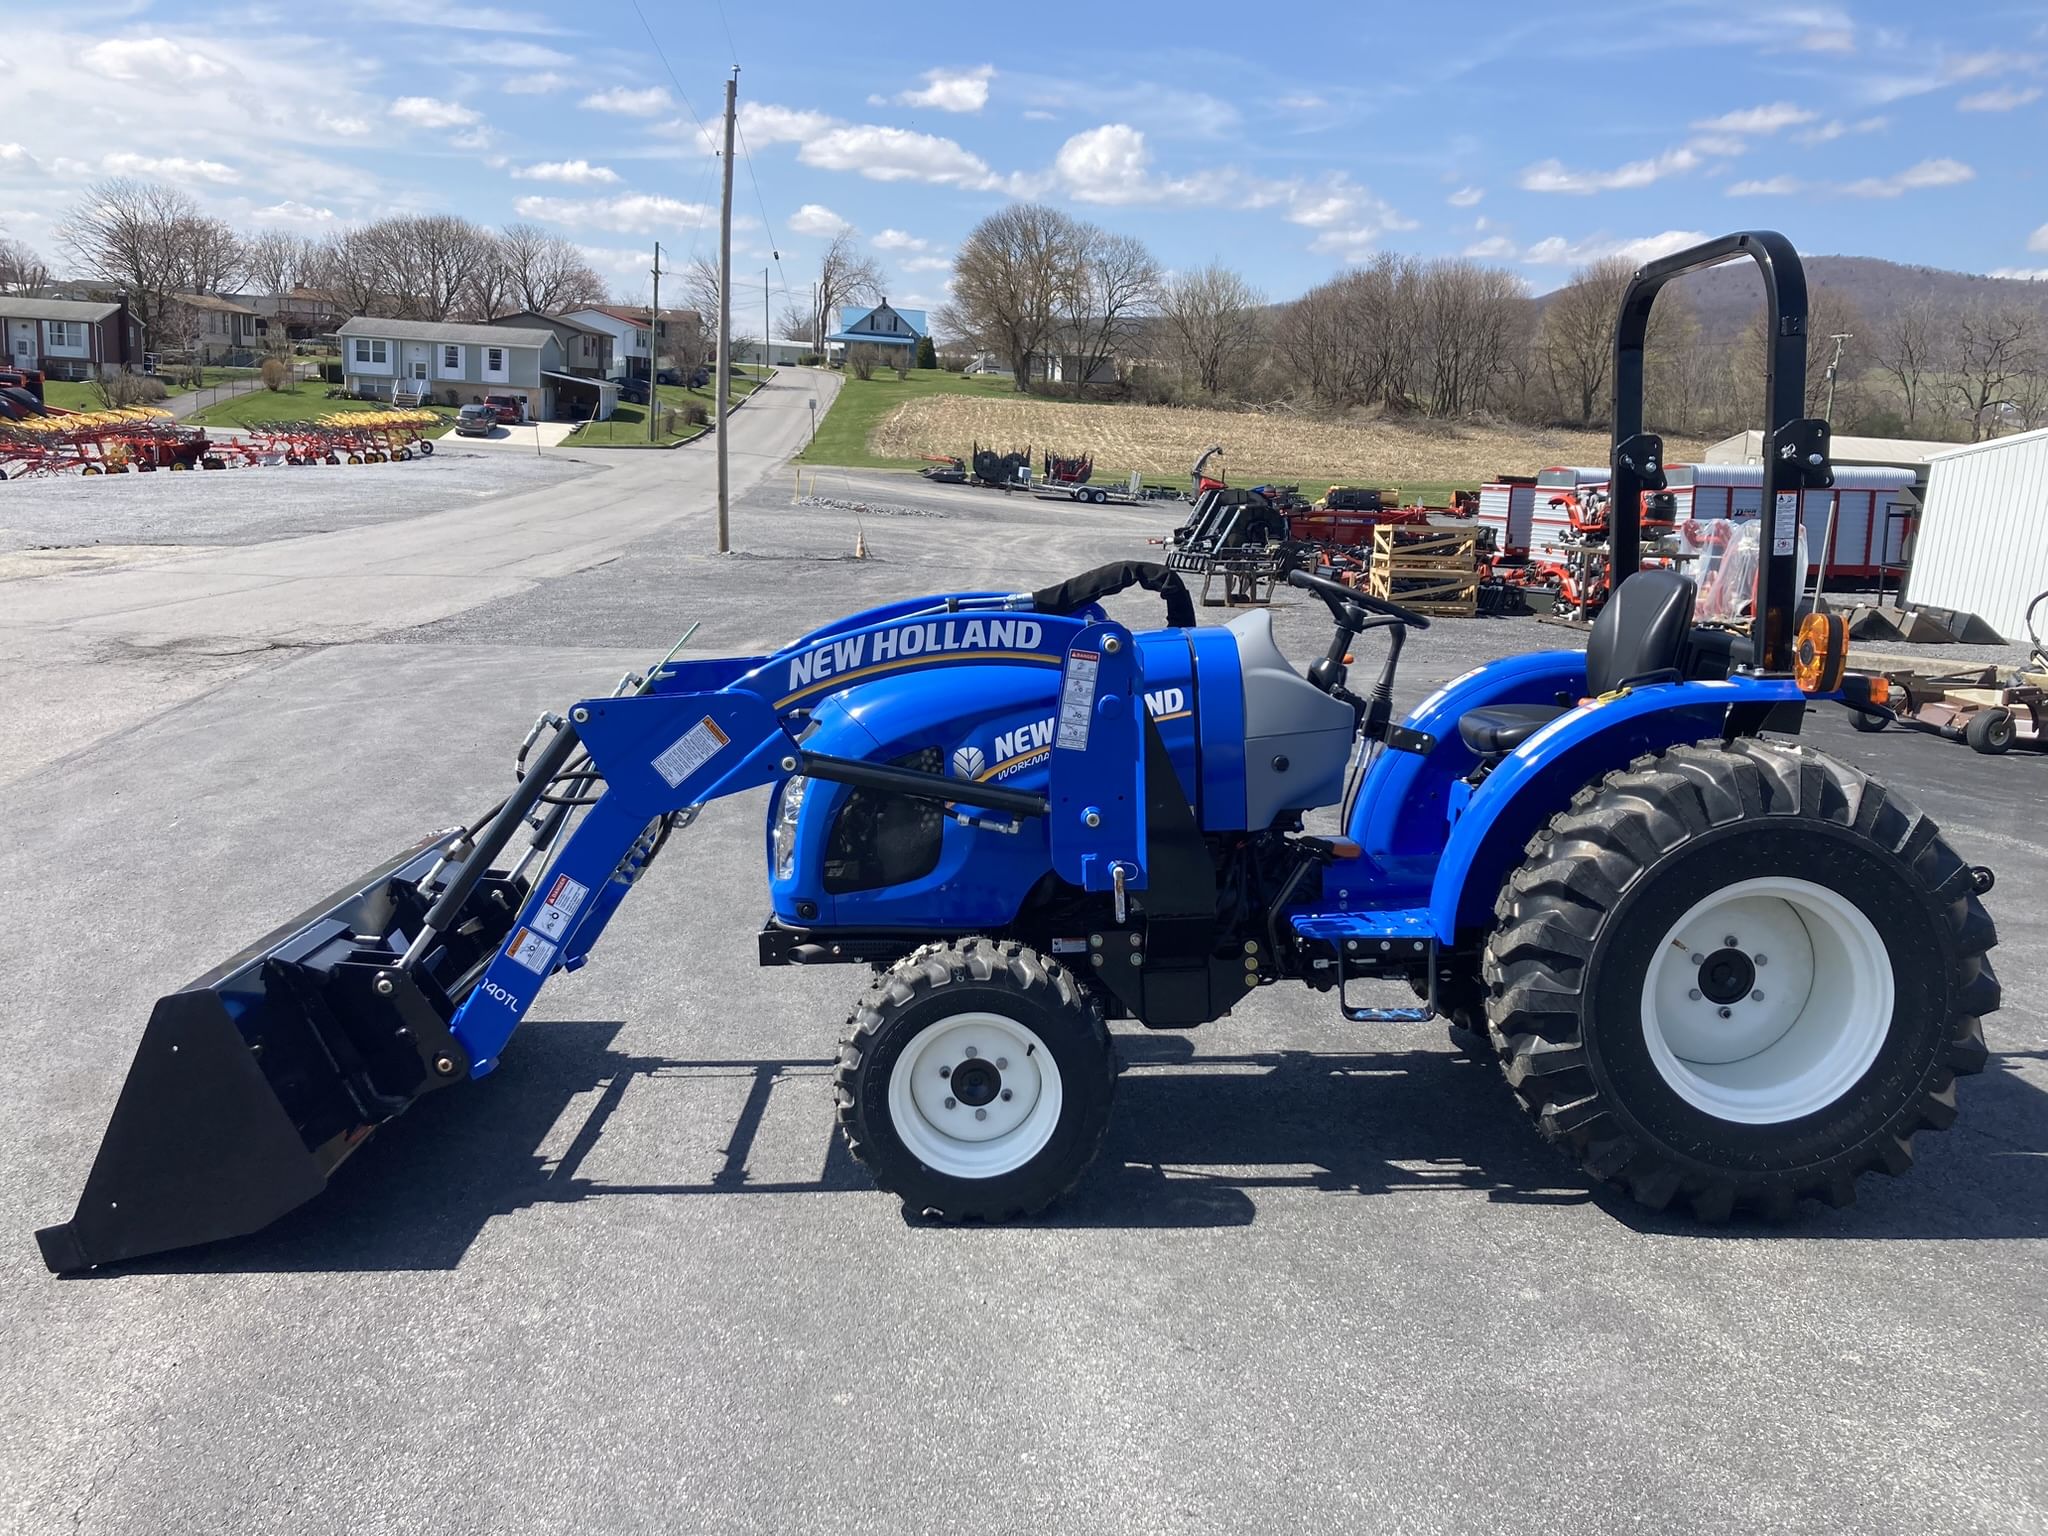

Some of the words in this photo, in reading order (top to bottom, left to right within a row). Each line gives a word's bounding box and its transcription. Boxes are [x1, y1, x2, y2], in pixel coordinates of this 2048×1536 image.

[789, 634, 866, 691] NEW
[872, 620, 1042, 661] HOLLAND
[994, 717, 1055, 763] NEW
[481, 977, 518, 1013] 140TL
